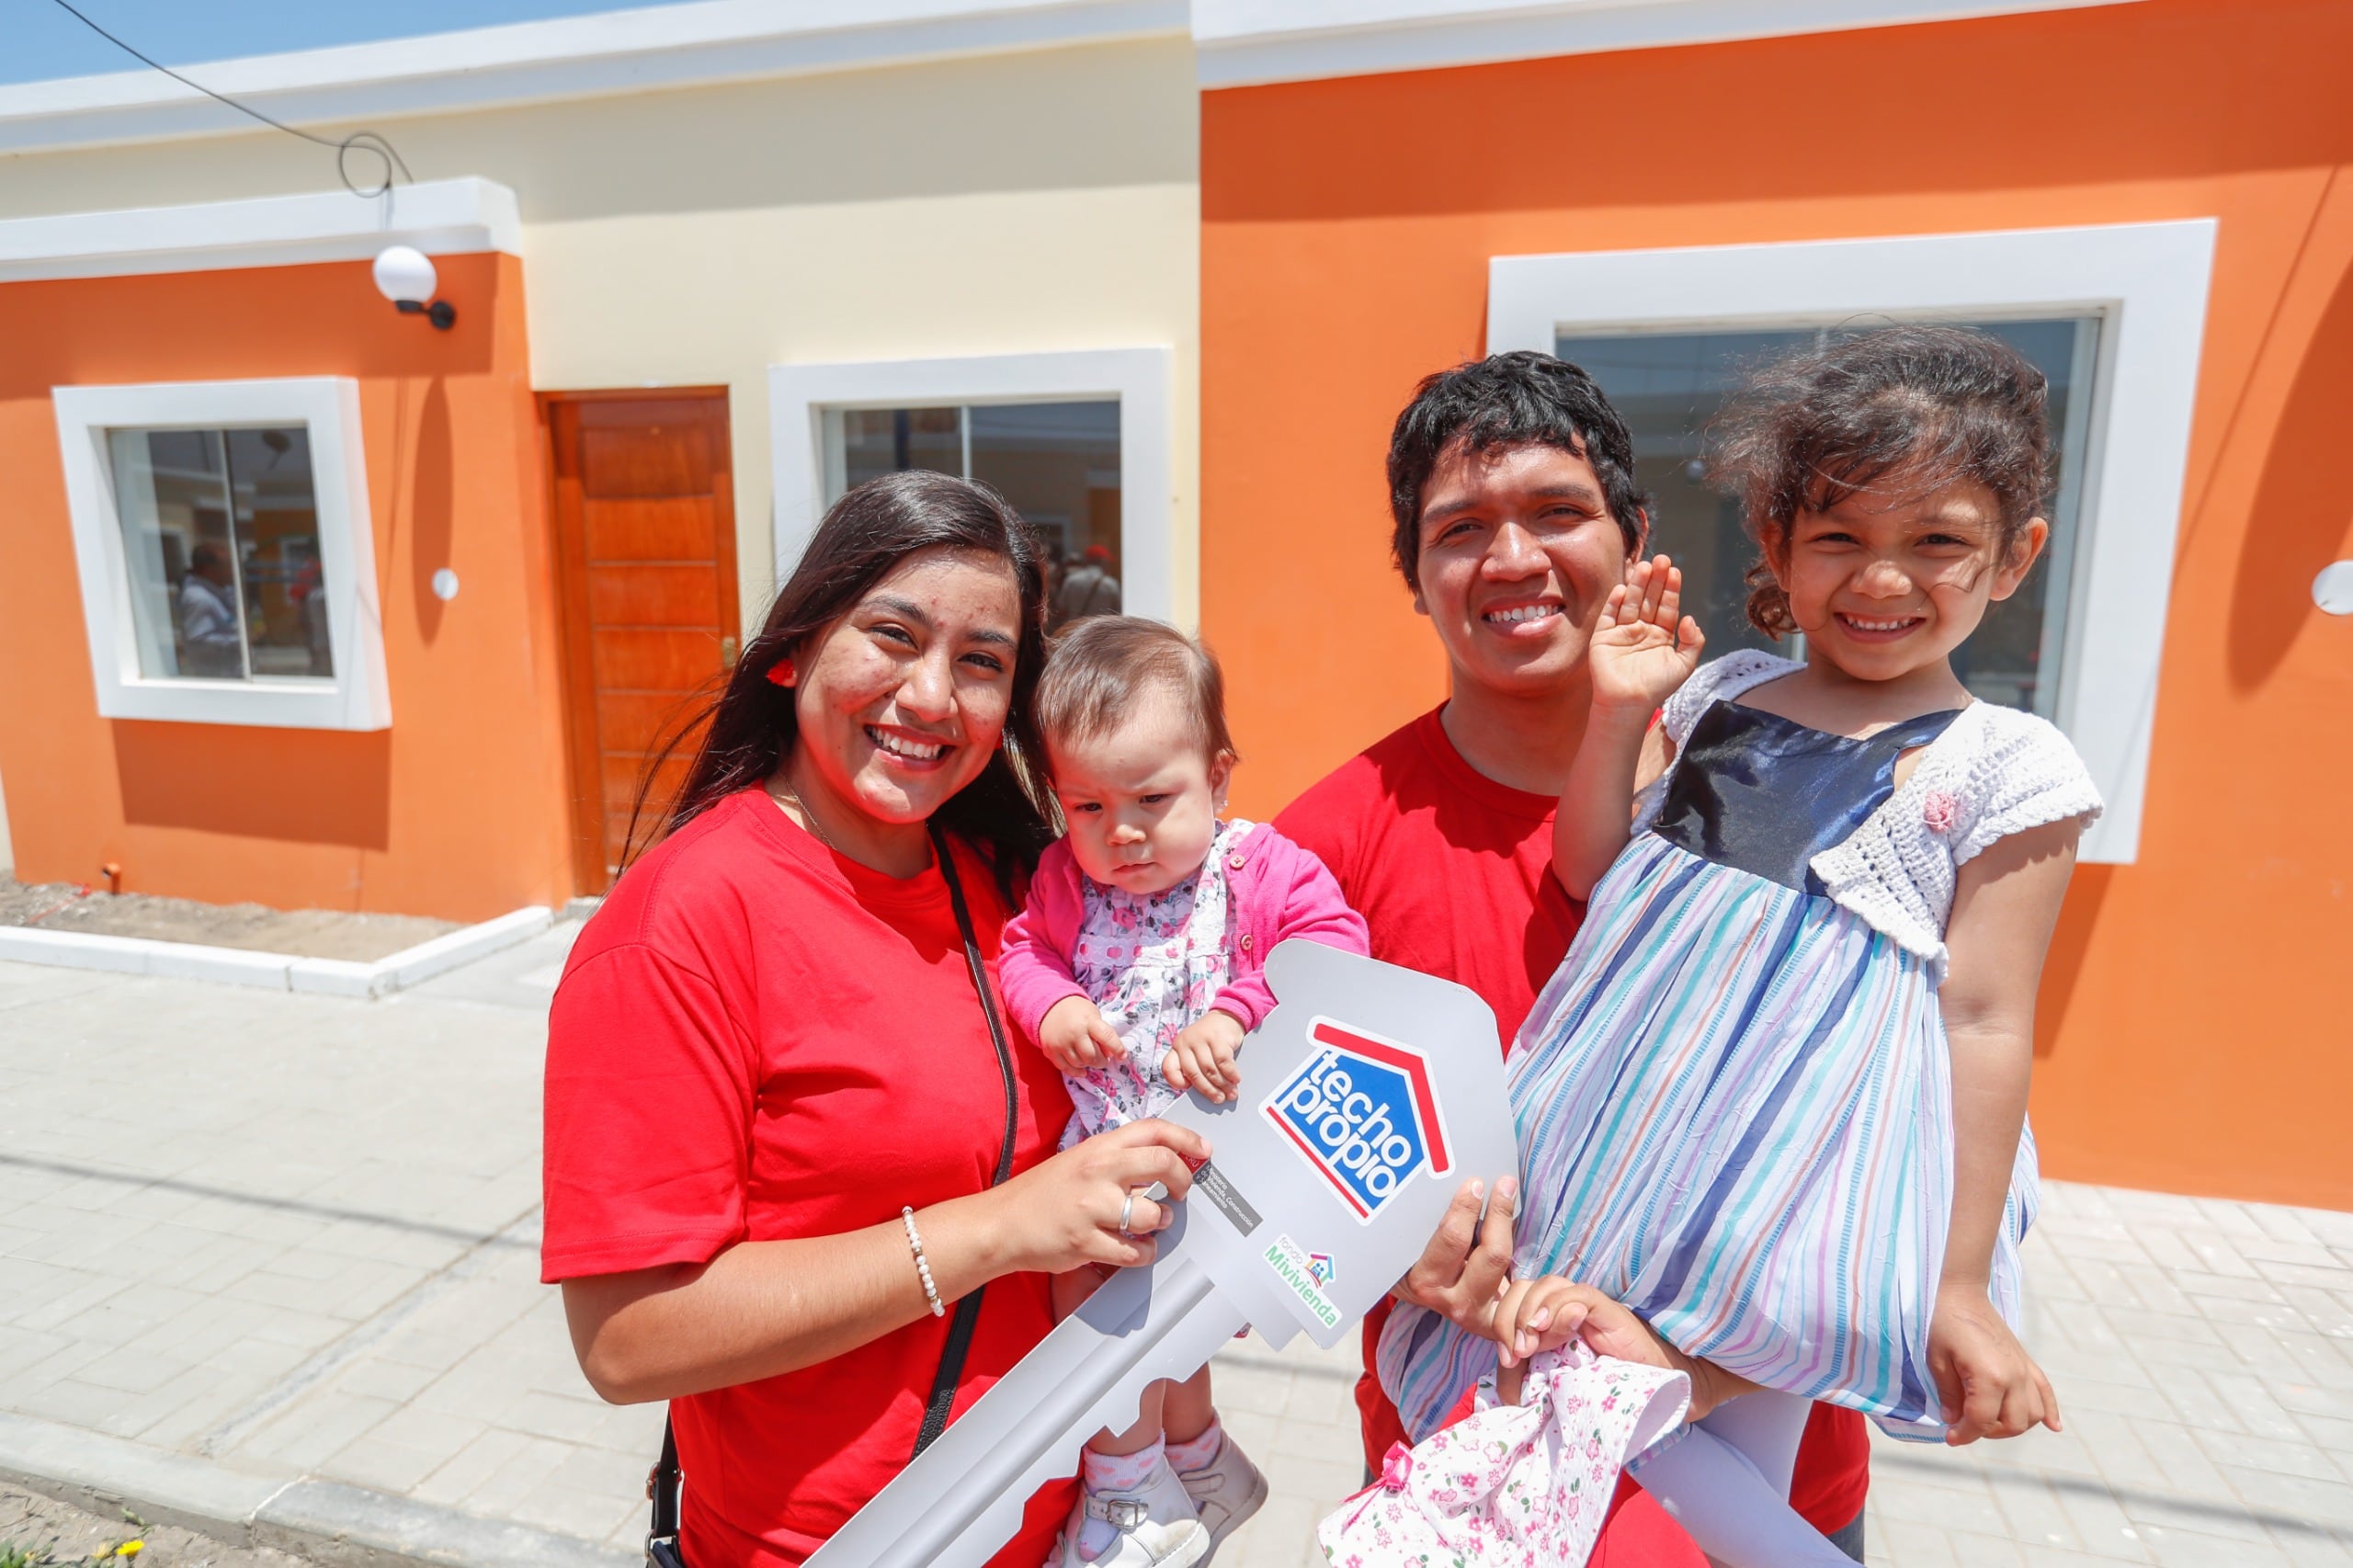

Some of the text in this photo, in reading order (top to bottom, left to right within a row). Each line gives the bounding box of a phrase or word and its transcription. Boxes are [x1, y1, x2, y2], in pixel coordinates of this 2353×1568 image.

[1310, 1052, 1412, 1167] techo
[1199, 1177, 1227, 1208] Saneamiento
[1225, 1197, 1254, 1227] Construcción
[1279, 1236, 1303, 1265] fondo
[1265, 1245, 1336, 1325] Mivivienda
